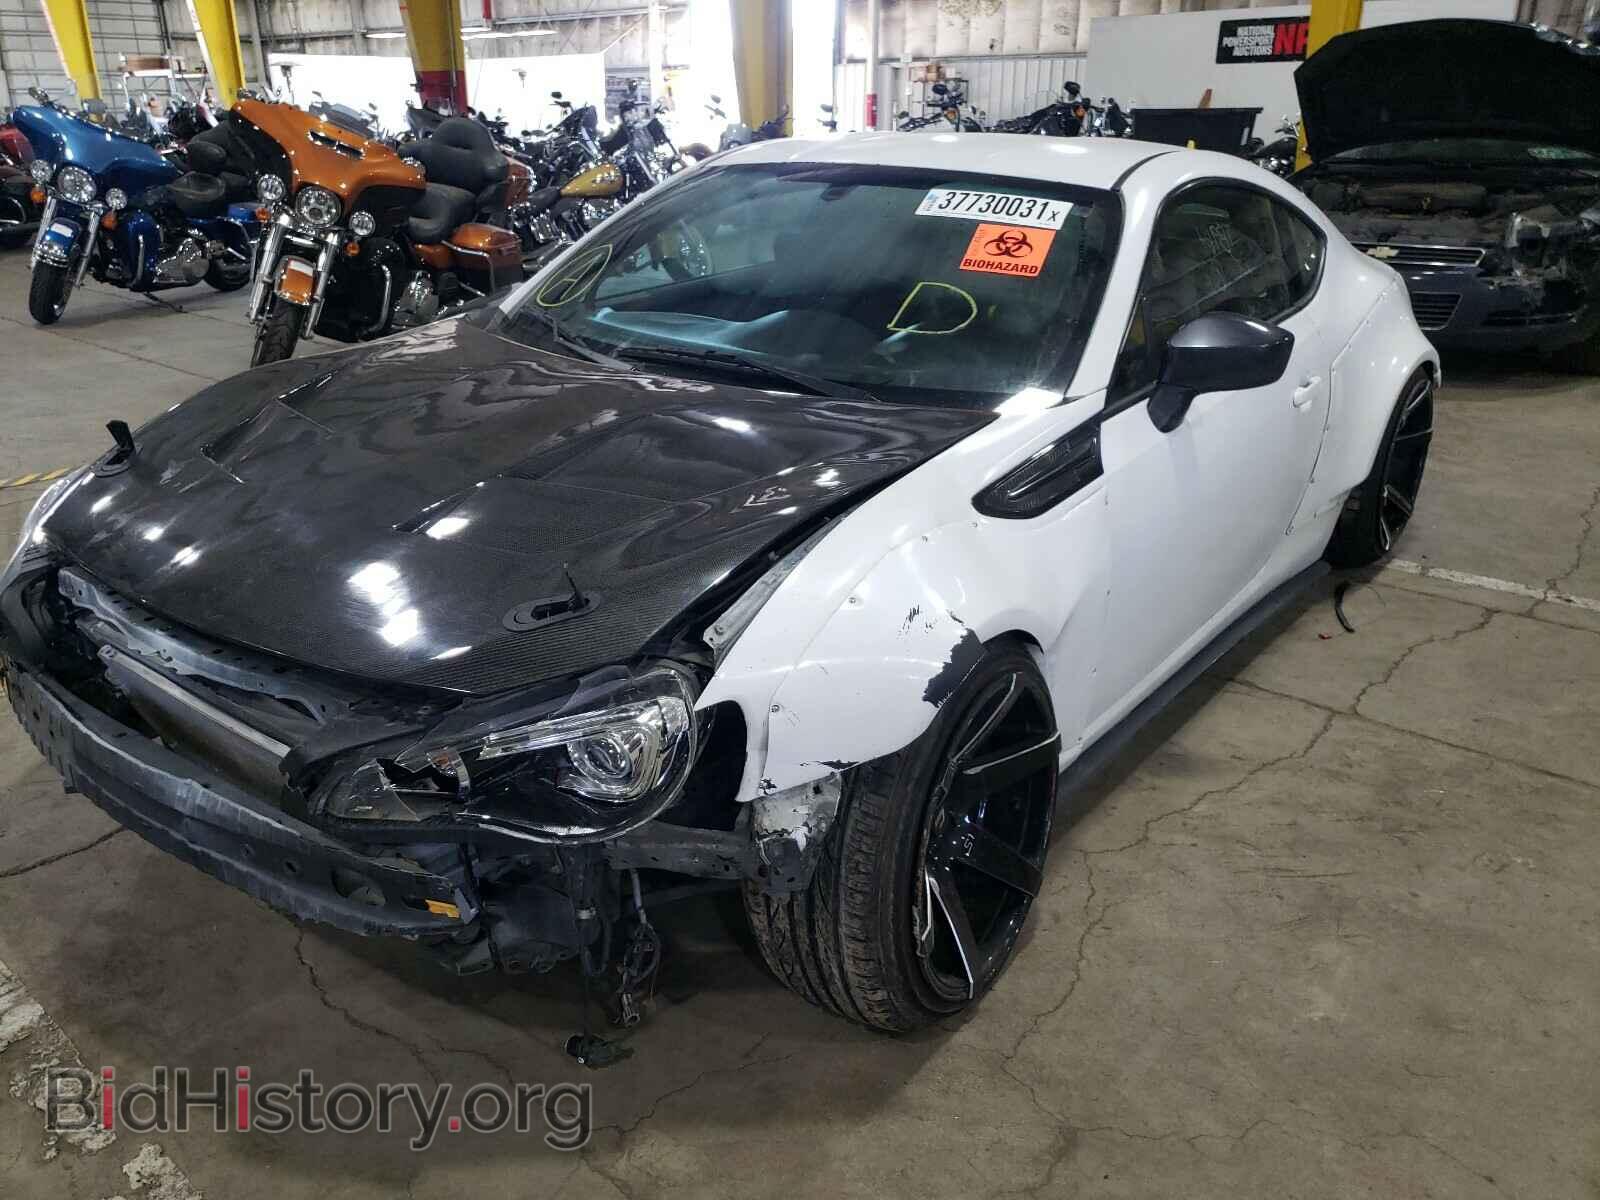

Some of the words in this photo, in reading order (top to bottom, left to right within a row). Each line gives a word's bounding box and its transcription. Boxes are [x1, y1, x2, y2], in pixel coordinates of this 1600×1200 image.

[1237, 25, 1275, 37] NATIONAL
[1232, 45, 1273, 56] AUCTIONS
[962, 258, 1039, 275] BIOHAZARD
[887, 281, 978, 335] D
